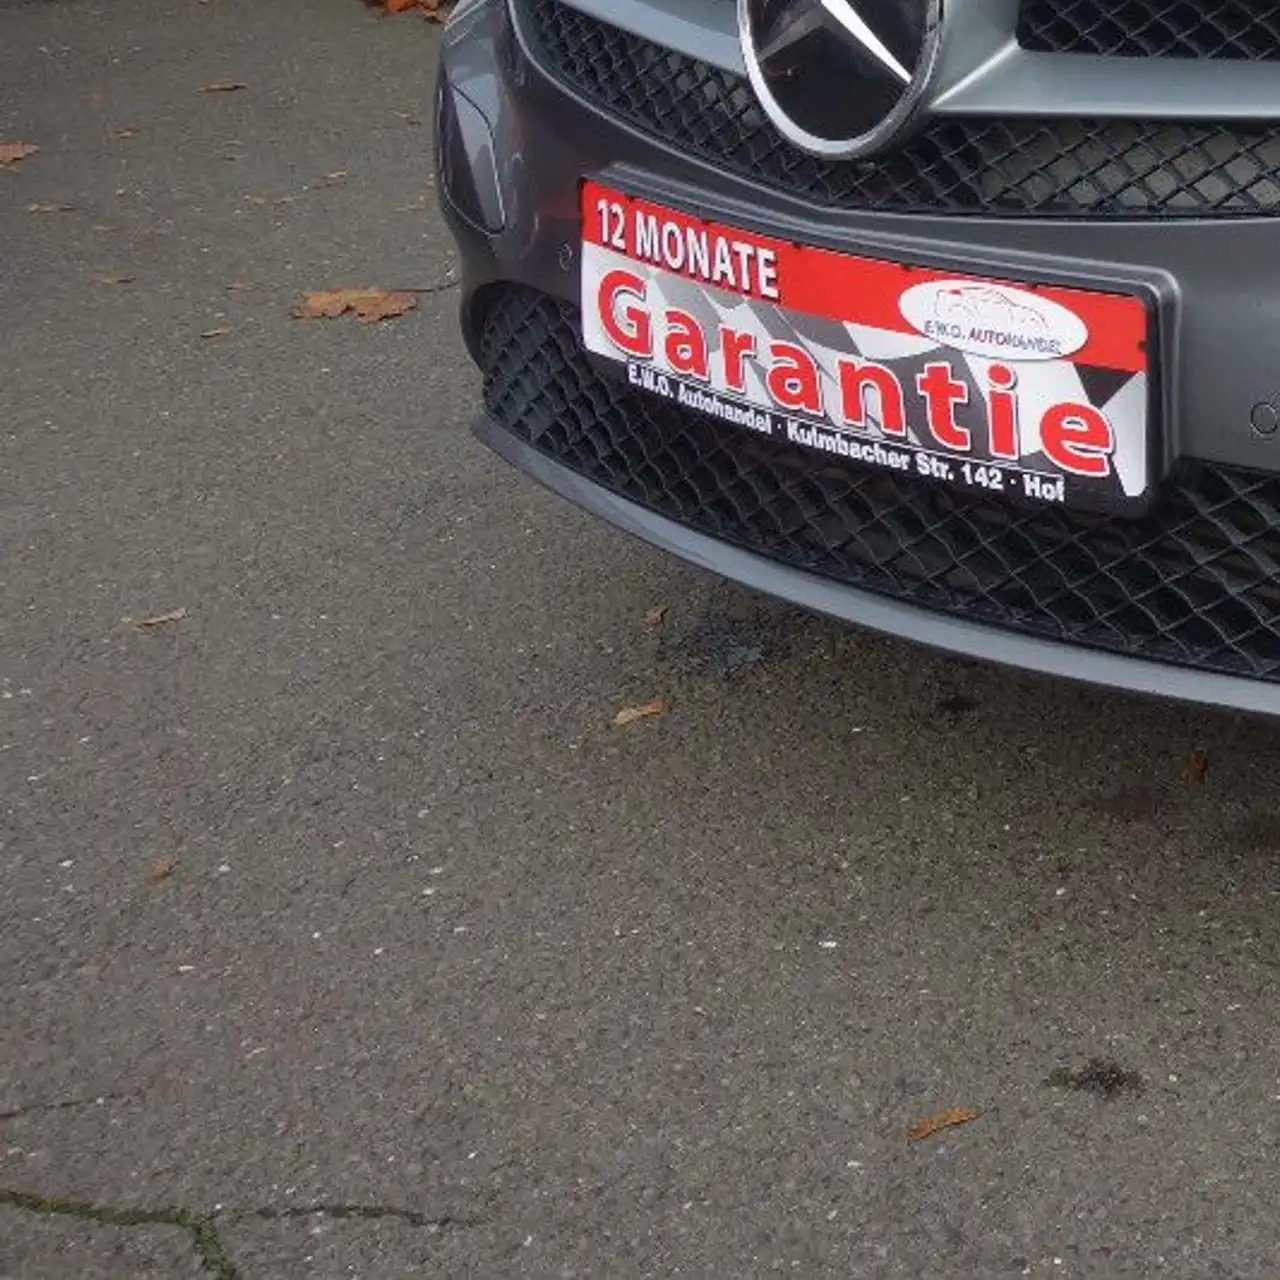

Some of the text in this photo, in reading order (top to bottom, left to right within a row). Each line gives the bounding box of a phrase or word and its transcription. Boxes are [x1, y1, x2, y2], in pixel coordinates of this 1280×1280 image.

[597, 198, 780, 300] 12 MONATE
[596, 267, 1116, 477] Garantie
[627, 363, 1065, 502] E.W.O. Autohandel Kulmbacher Str. 142 Hof
